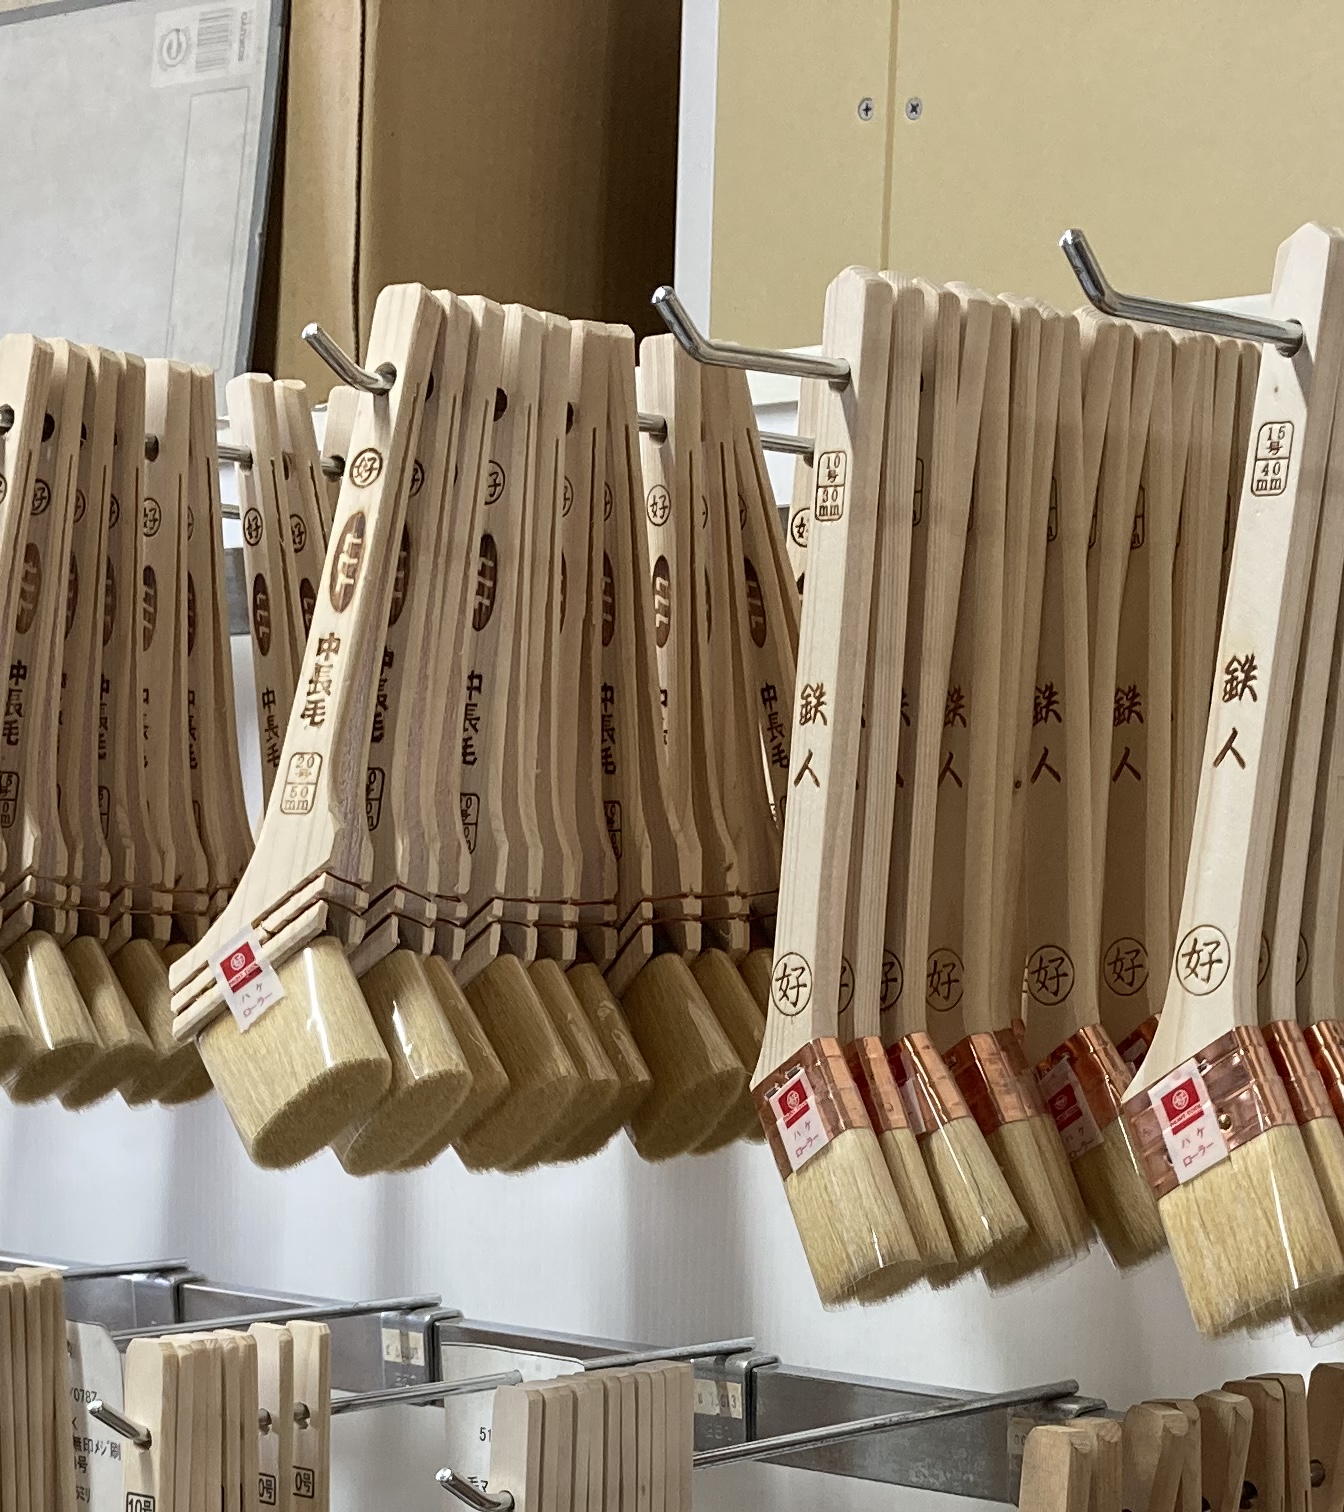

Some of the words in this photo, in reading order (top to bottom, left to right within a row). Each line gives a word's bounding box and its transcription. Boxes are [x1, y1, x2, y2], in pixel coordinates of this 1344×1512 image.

[352, 451, 381, 486] 好
[244, 510, 261, 544] 好
[649, 488, 668, 523] 好
[3, 659, 28, 746] 中長毛
[300, 631, 342, 728] 中長毛
[793, 682, 828, 788] 鉄人
[1031, 681, 1062, 784] 鉄人
[1112, 683, 1144, 784] 鉄人
[1212, 653, 1258, 769] 鉄人
[773, 957, 810, 1012] 好
[927, 955, 962, 1007] 好
[1030, 949, 1072, 1002] 好
[1106, 941, 1146, 992] 好
[1179, 932, 1227, 990] 好
